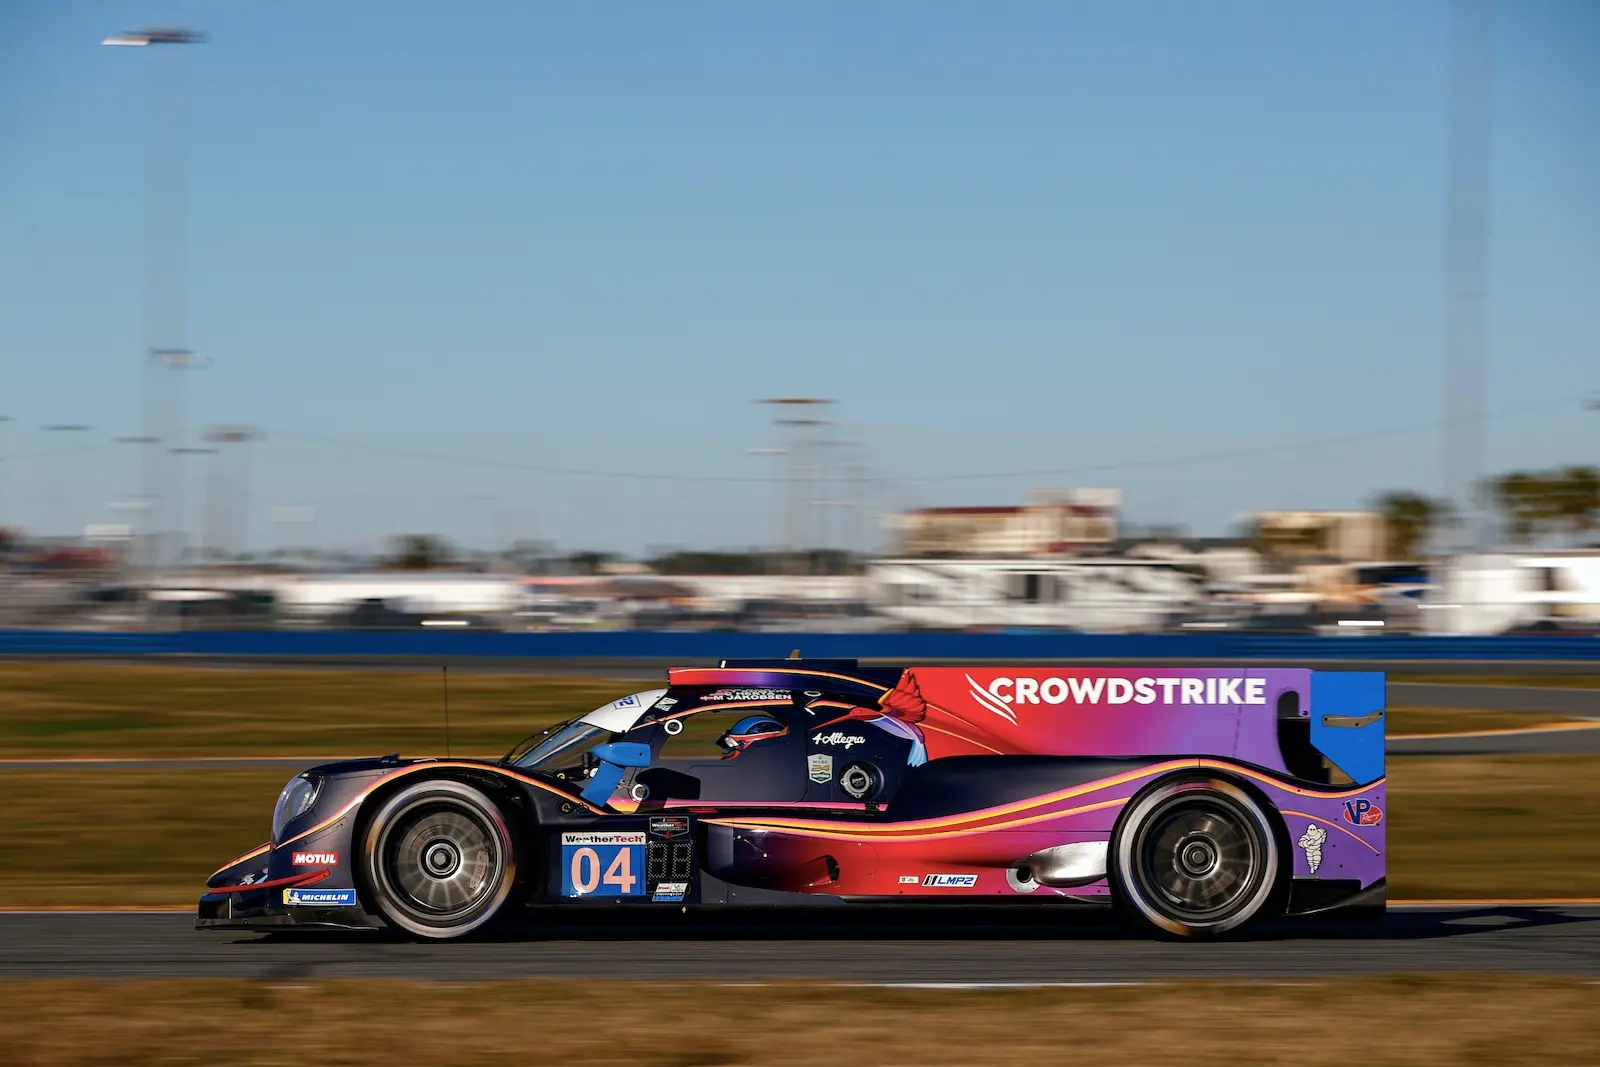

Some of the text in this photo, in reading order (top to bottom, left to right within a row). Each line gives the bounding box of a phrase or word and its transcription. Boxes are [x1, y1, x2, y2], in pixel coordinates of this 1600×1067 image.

[988, 677, 1266, 705] CROWDSTRIKE
[1345, 798, 1371, 825] VP
[565, 835, 643, 843] WeatherTech
[294, 853, 336, 864] MOTUL
[571, 847, 636, 893] 04
[937, 876, 974, 885] LMP2
